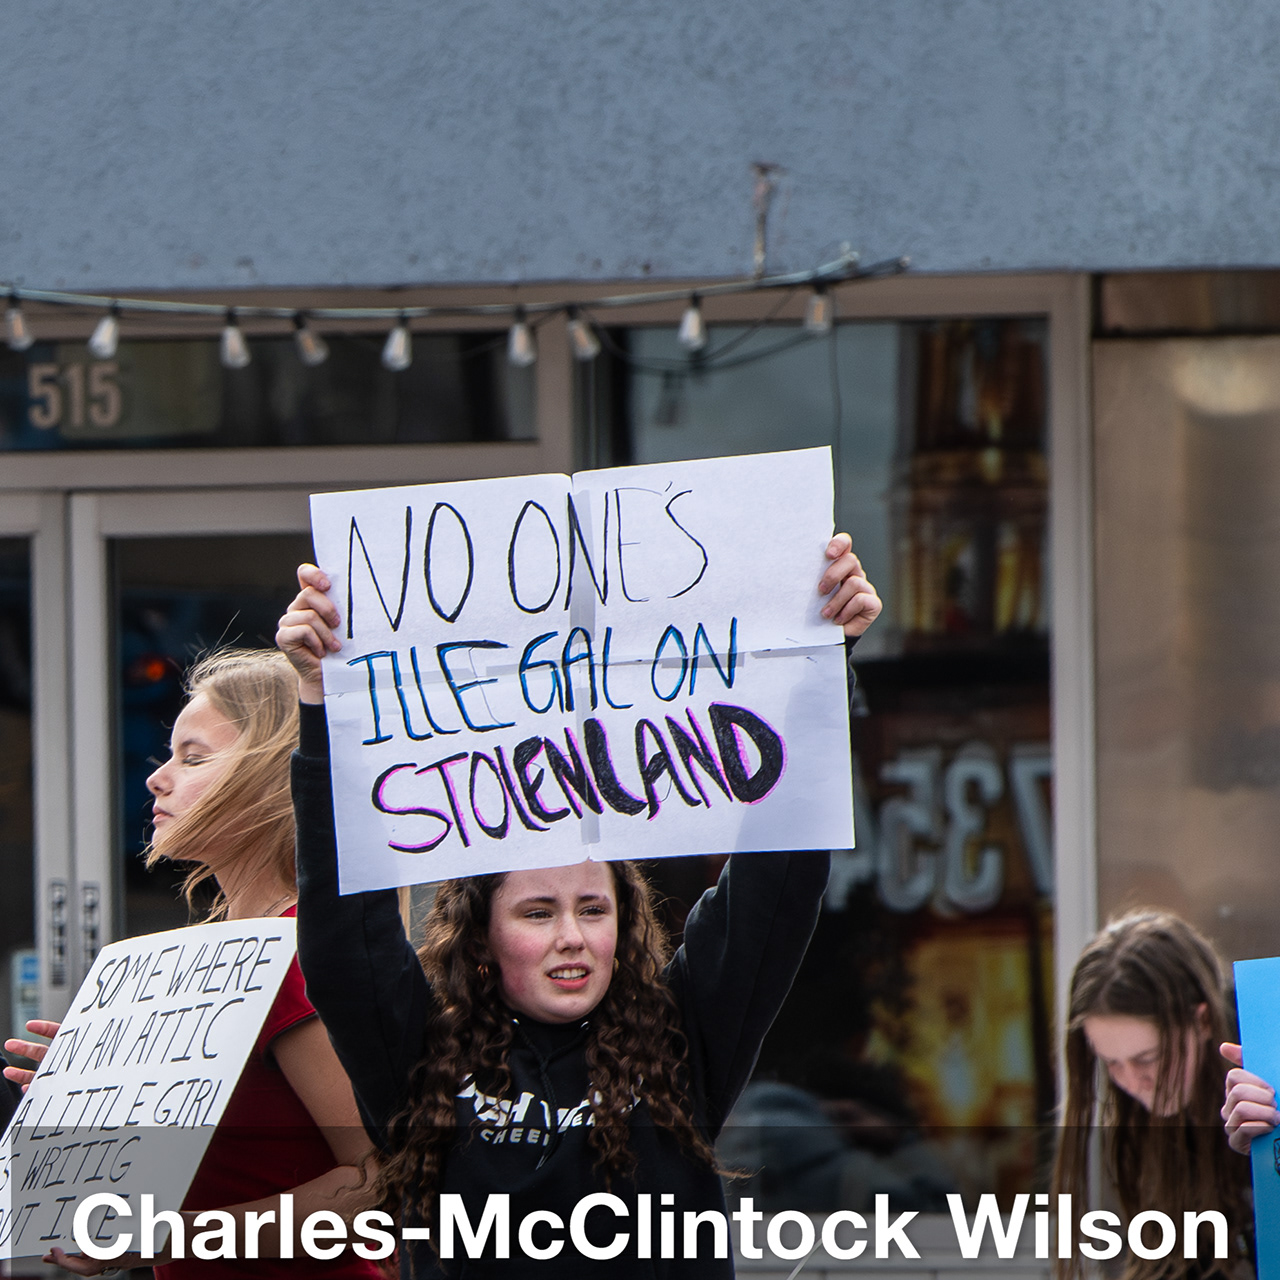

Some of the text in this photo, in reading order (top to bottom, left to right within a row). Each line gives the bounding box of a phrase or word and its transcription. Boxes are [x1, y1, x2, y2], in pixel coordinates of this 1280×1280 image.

[27, 362, 122, 430] 515
[346, 480, 709, 640] NO ONE'S
[347, 616, 739, 746] ILLEGAL ON
[80, 935, 282, 1014] SOMEWHERE
[36, 997, 245, 1079] IN AN ATTIC
[1, 1077, 224, 1147] A LITTLE GIRL
[40, 1193, 131, 1241] I.E
